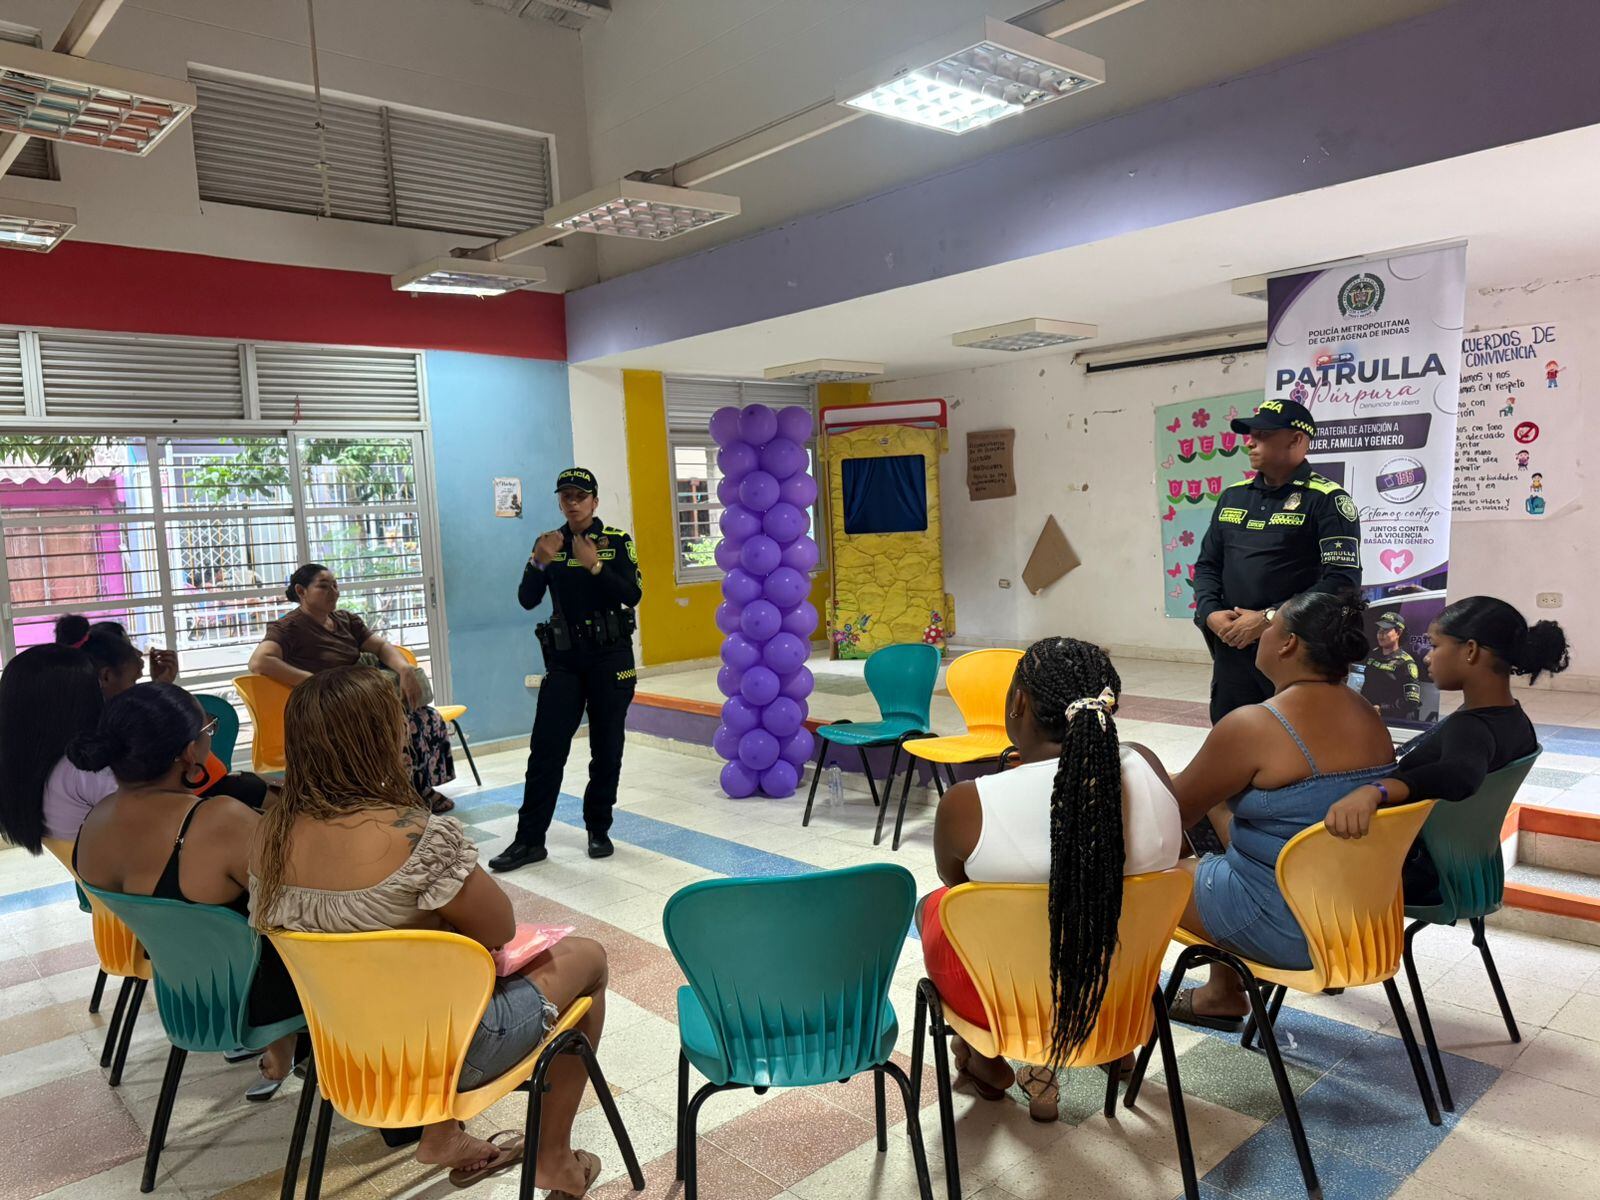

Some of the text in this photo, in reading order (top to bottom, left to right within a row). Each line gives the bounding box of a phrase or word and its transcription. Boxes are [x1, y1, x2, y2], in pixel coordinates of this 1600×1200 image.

[1308, 318, 1411, 337] POLICÍA METROPOLITANA
[1308, 337, 1318, 346] DE
[1319, 332, 1369, 344] CARTAGENA
[1381, 326, 1411, 337] INDIAS
[1462, 326, 1557, 353] CUERDOS DE
[1465, 344, 1537, 368] CONVIVENCIA
[1276, 353, 1447, 391] PATRULLA
[1496, 370, 1511, 379] nos
[1495, 378, 1525, 394] respeto
[1308, 374, 1421, 417] Púrpura
[1359, 400, 1392, 409] Denunciar
[1400, 399, 1420, 407] libera
[1315, 427, 1347, 437] TRATEGIA
[1349, 425, 1358, 435] DE
[1393, 421, 1399, 432] A
[1465, 431, 1505, 441] adecuado
[1309, 439, 1330, 450] UJER,
[1330, 436, 1363, 449] FAMILIA
[1364, 436, 1370, 446] Y
[1358, 505, 1441, 523] Estamos contigo
[1368, 525, 1398, 533] JUNTOS
[1384, 531, 1423, 539] VIOLENCIA
